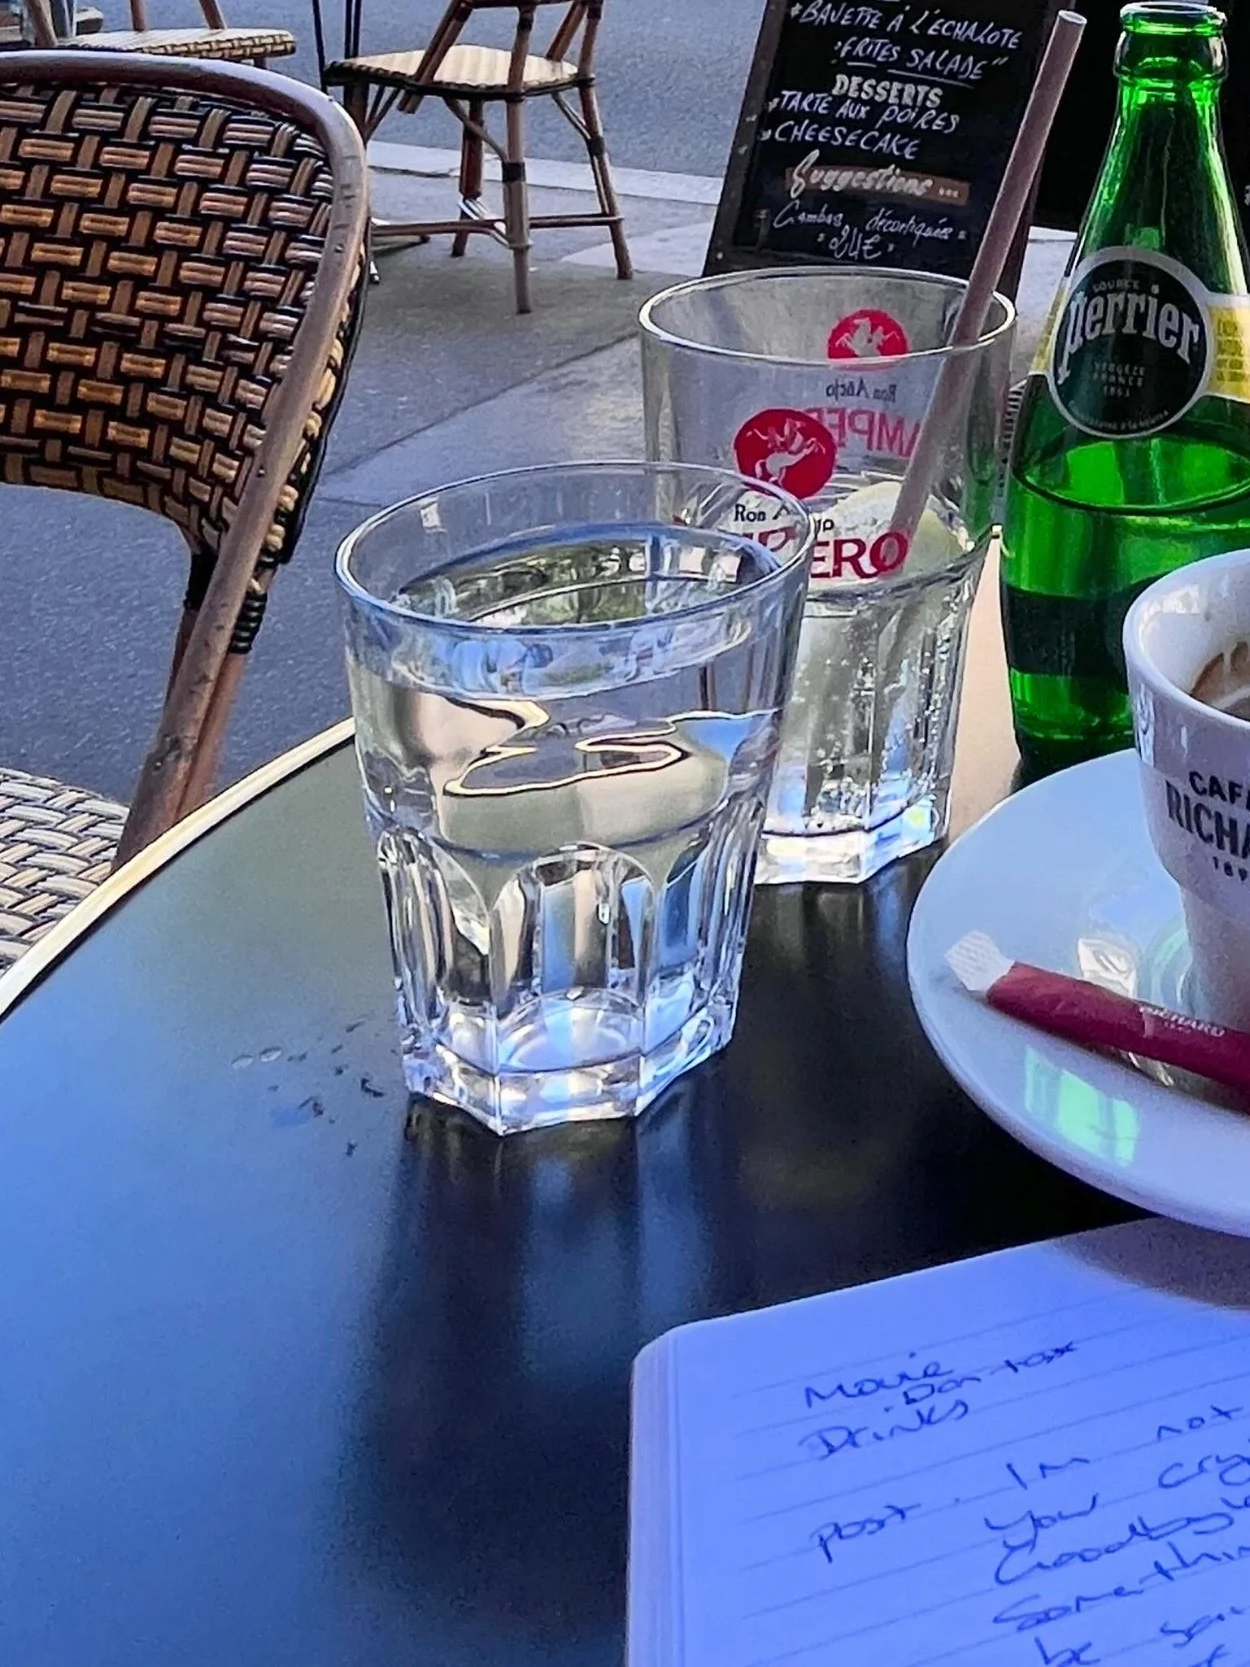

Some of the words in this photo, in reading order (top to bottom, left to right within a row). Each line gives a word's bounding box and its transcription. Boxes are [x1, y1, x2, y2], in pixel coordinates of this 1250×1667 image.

[800, 0, 883, 29] BAVETTE
[780, 90, 833, 115] TARTE
[835, 100, 871, 120] AUX
[832, 75, 943, 109] DESSERTS
[774, 119, 920, 160] CHEESECAKE
[790, 149, 935, 199] Suggestions
[734, 503, 766, 522] Ron
